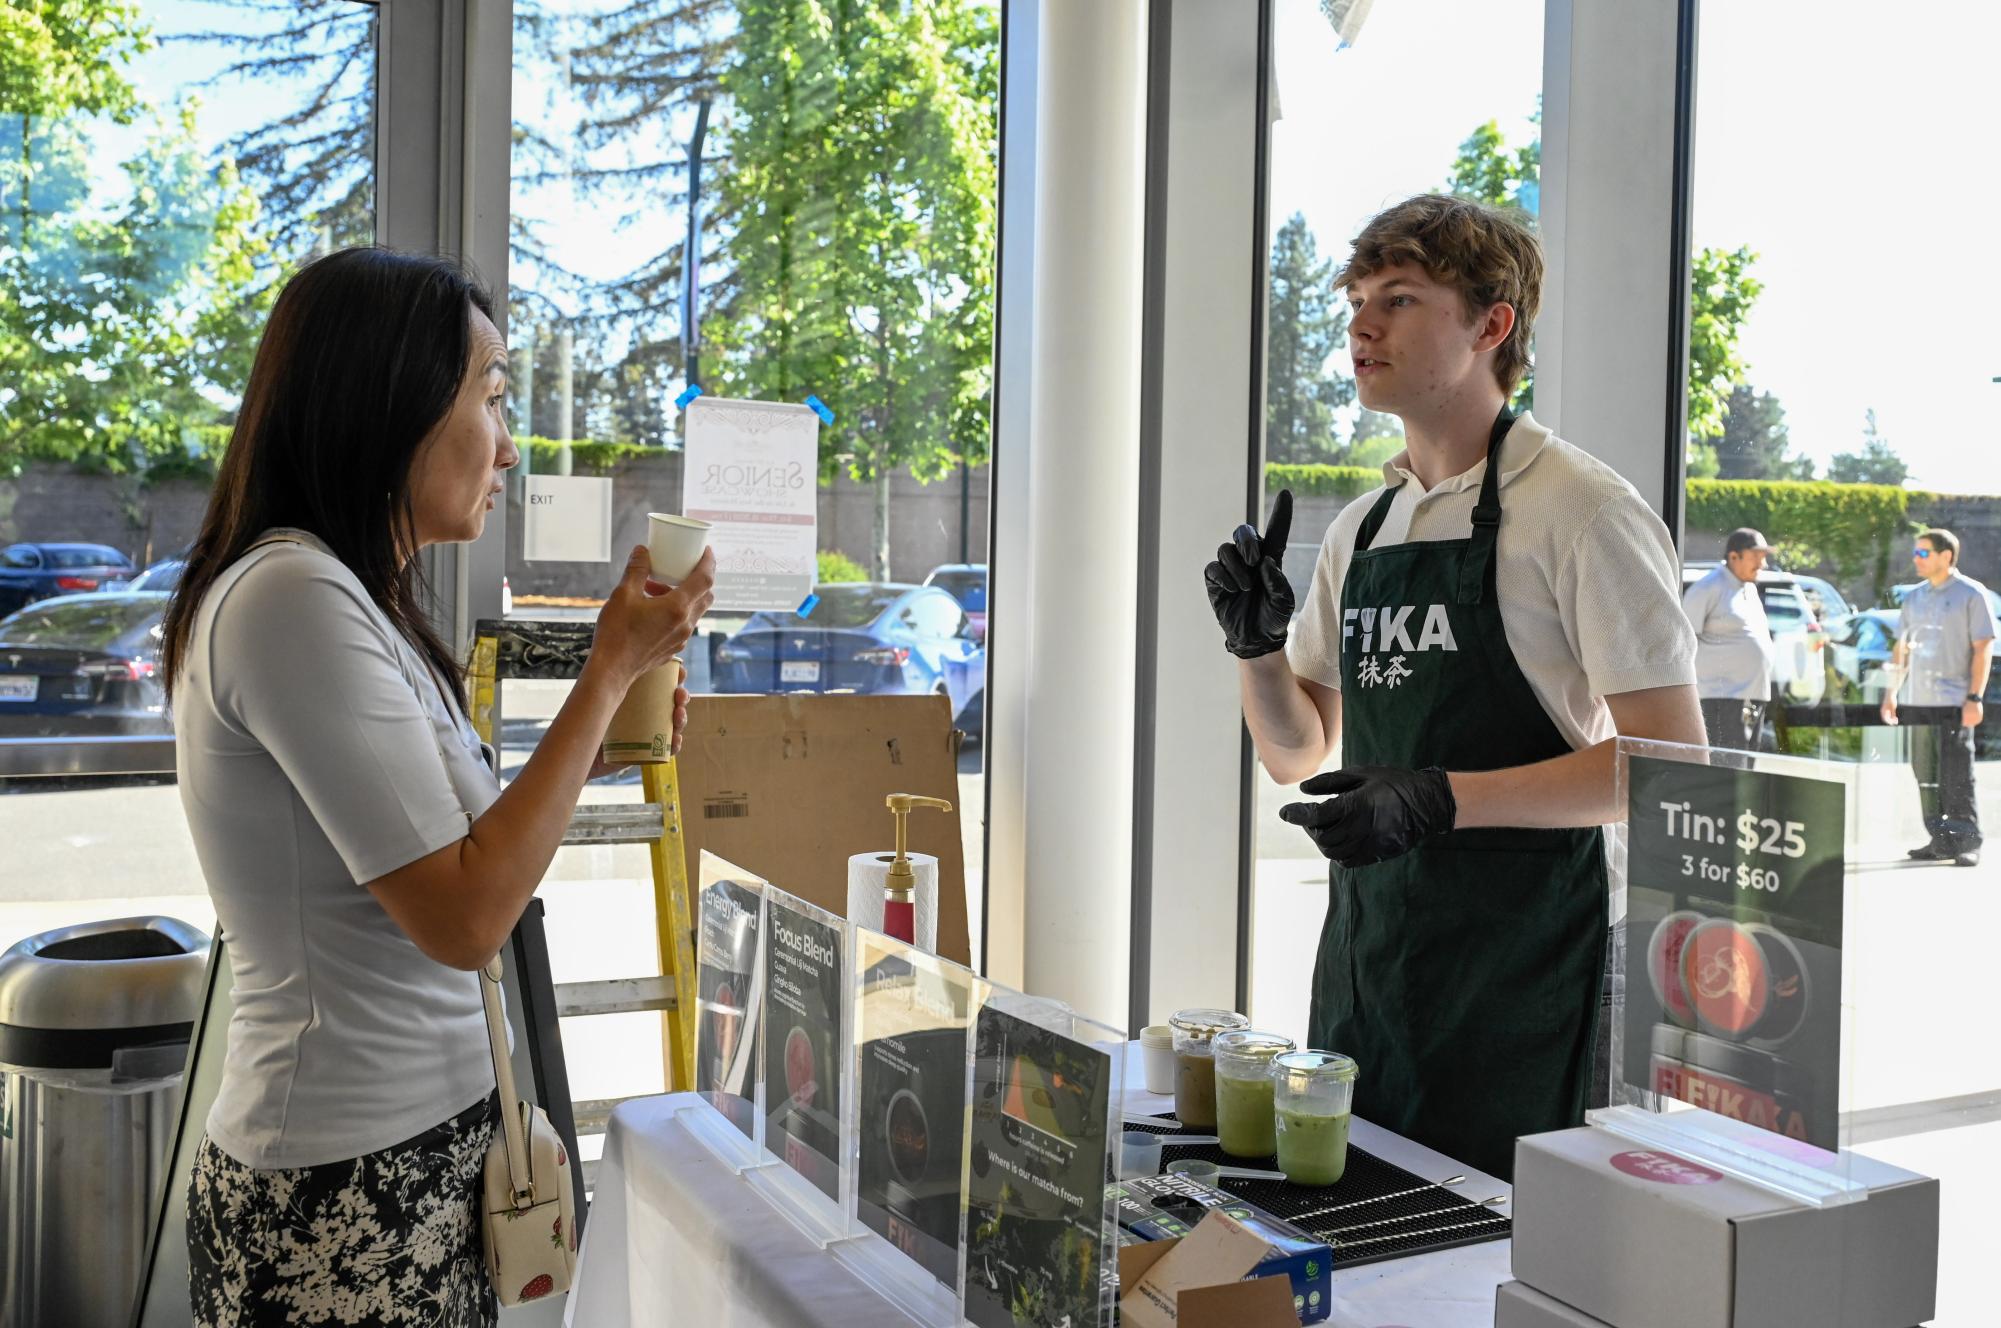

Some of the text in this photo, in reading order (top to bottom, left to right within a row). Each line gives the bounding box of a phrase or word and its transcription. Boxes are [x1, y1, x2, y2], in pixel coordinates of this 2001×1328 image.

[530, 495, 553, 504] EXIT
[1342, 604, 1458, 653] FIKA
[1357, 655, 1414, 690] 抹茶
[1660, 802, 1806, 859] Tin: $25
[1681, 855, 1780, 893] 3 for $60
[705, 887, 732, 920] Energy
[774, 920, 833, 968] Focus Blend
[774, 947, 796, 966] Ceremonial
[802, 961, 819, 977] Matcha
[988, 1149, 1010, 1170] Where
[1011, 1161, 1018, 1175] is
[1018, 1167, 1031, 1181] our
[1032, 1174, 1059, 1196] matcha
[1060, 1187, 1084, 1209] from?
[1157, 1174, 1222, 1207] NITRILE
[1119, 1198, 1140, 1210] 100
